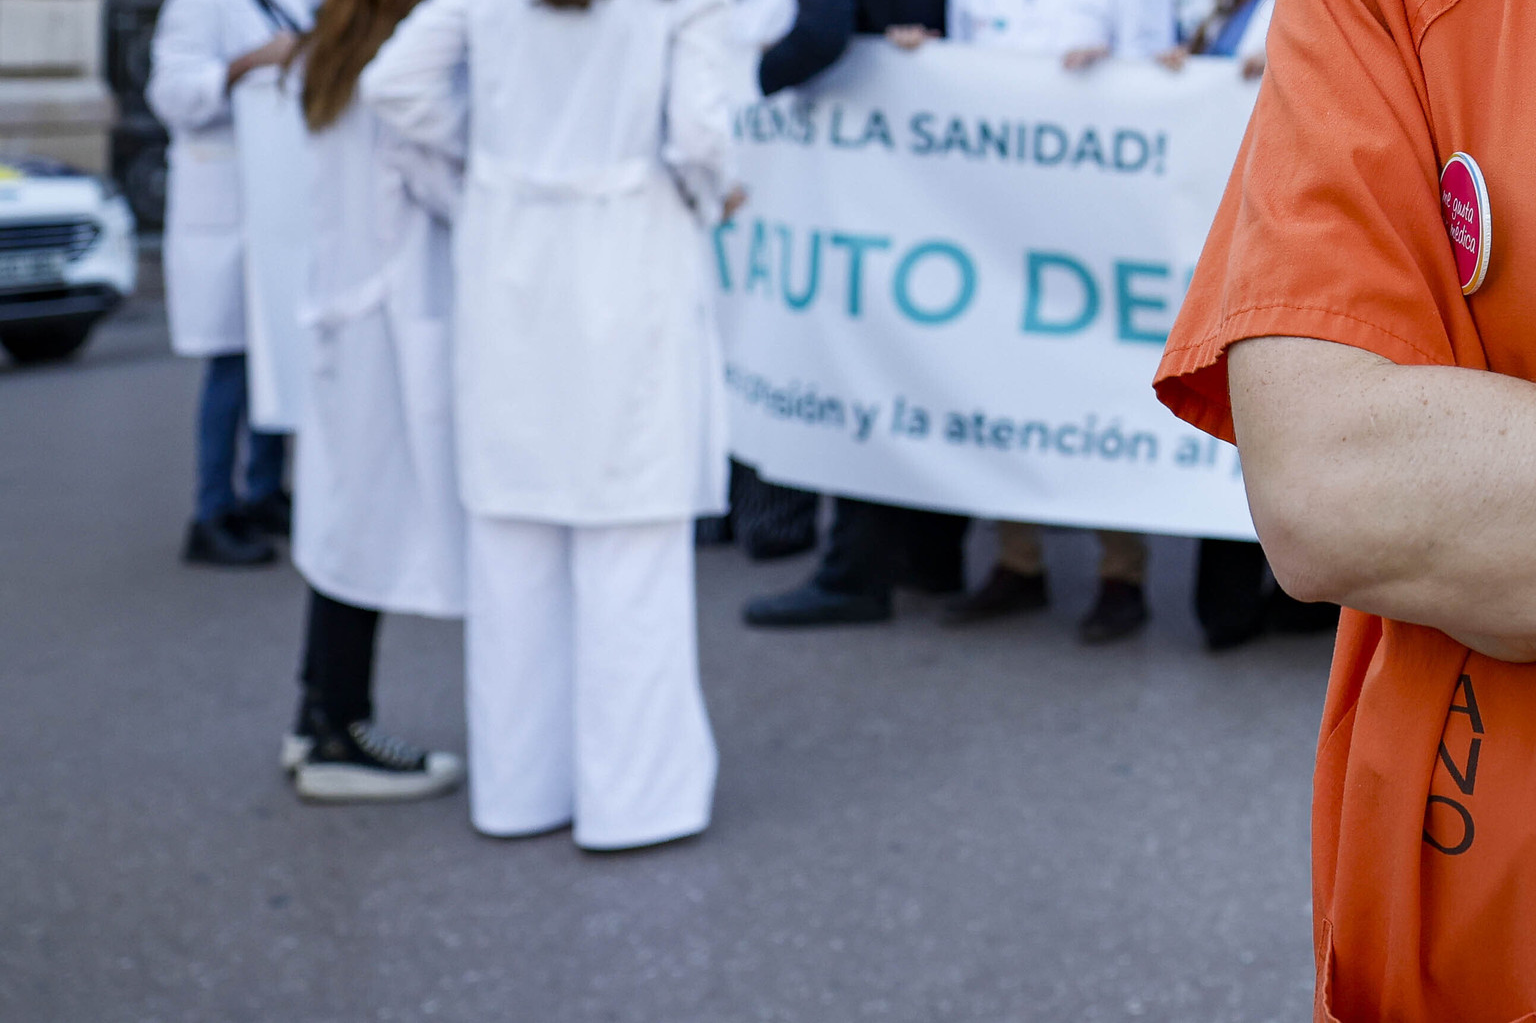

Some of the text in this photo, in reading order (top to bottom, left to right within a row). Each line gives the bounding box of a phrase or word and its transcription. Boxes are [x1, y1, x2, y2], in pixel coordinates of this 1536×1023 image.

[829, 104, 895, 150] LA
[908, 111, 1168, 175] SANIDAD!
[1450, 221, 1476, 254] médica
[1452, 198, 1474, 224] gusta
[1021, 248, 1196, 348] DE
[853, 400, 881, 444] y
[892, 394, 929, 439] la
[944, 407, 1158, 463] atención
[1174, 433, 1218, 469] al
